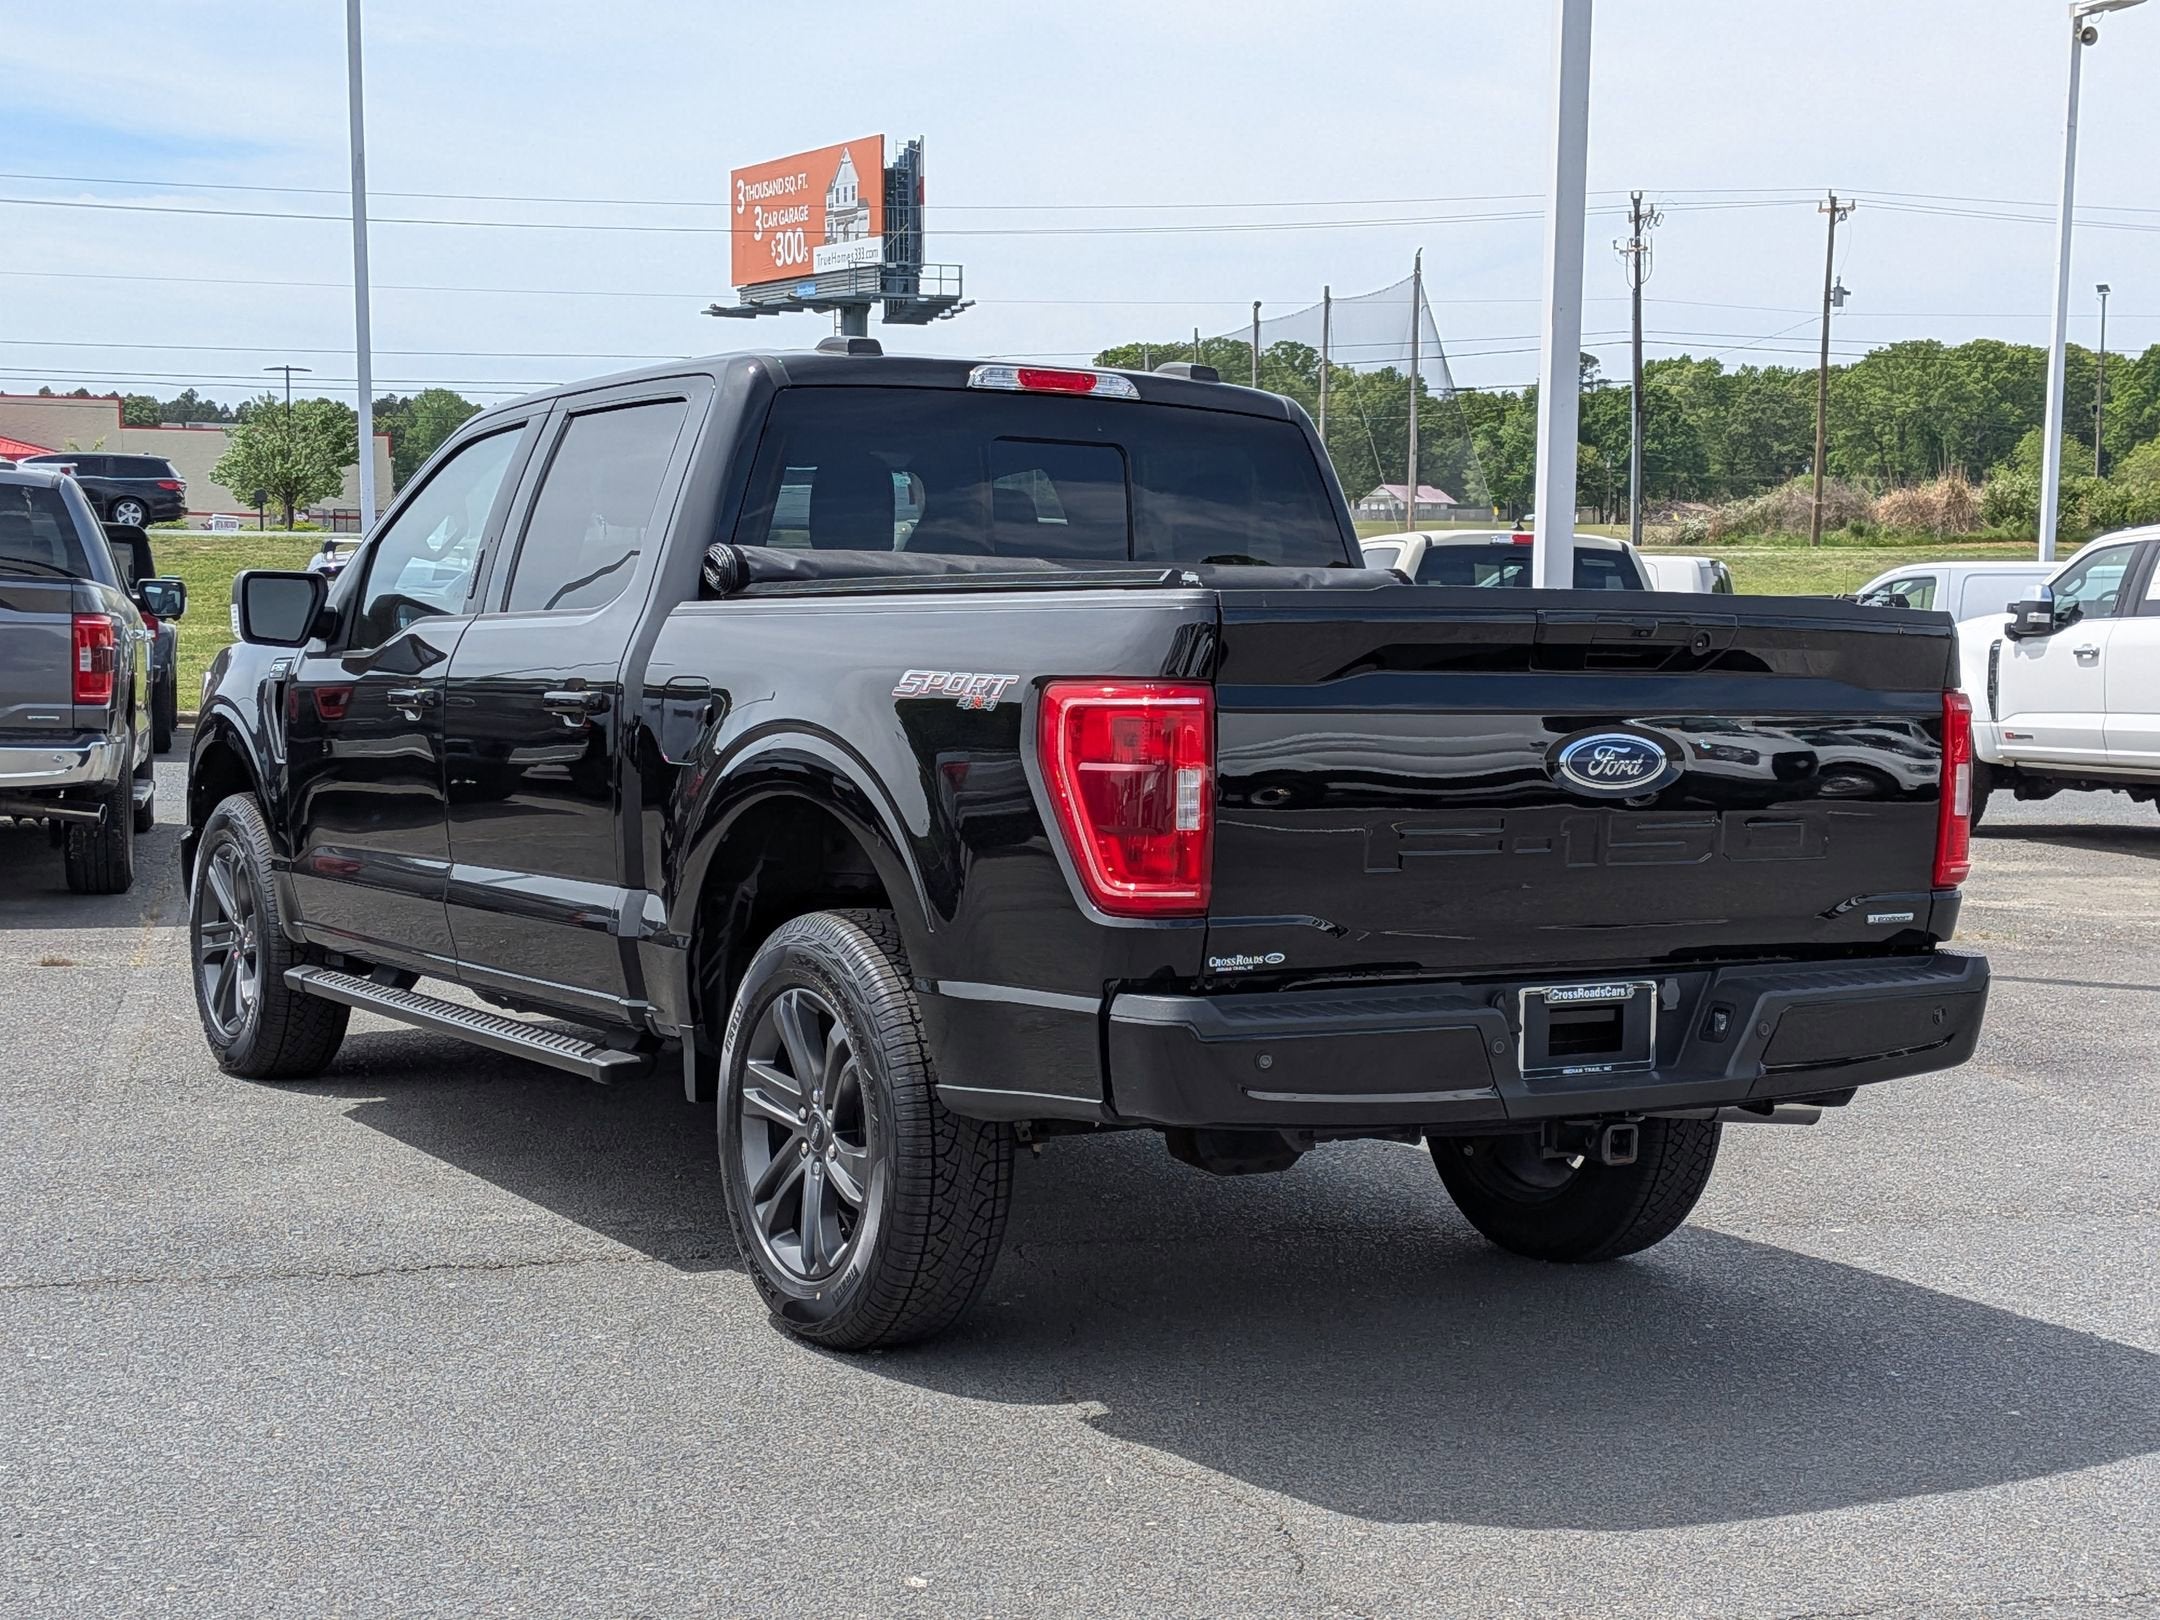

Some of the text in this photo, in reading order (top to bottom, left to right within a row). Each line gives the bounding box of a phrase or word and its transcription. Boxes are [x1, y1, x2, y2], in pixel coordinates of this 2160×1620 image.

[736, 173, 809, 214] 3 THOUSAND SQ. FT.
[754, 205, 809, 241] 3 CAR GARAGE
[892, 669, 1020, 698] SPORT
[1587, 745, 1645, 776] Ford
[1363, 809, 1830, 874] F-150
[1551, 985, 1627, 1001] CrossRoadsCars
